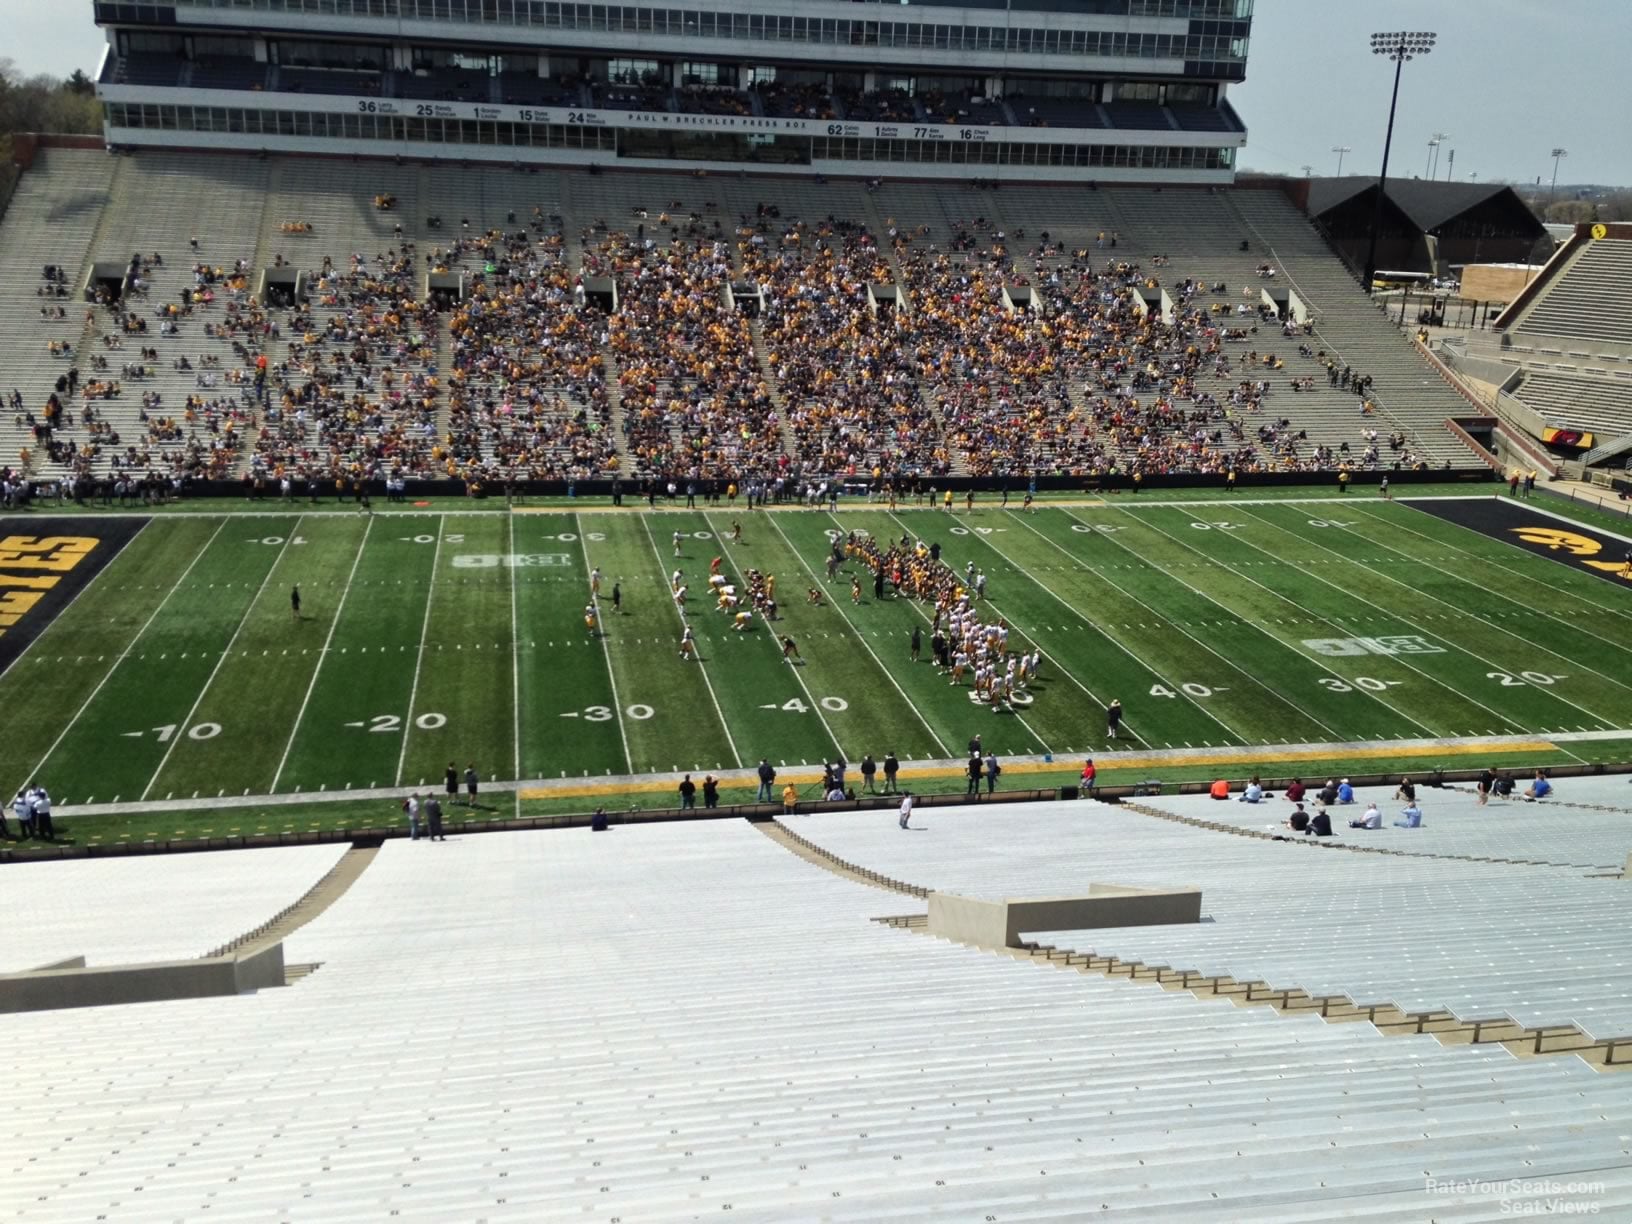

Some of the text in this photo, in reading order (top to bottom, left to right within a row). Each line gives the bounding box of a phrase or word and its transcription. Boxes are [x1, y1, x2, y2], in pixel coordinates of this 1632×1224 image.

[358, 100, 376, 113] 36
[416, 104, 433, 116] 25
[473, 107, 479, 118] 1
[519, 110, 532, 121] 15
[568, 112, 584, 123] 24
[628, 113, 657, 122] PAUL
[676, 116, 735, 125] BRECHLER
[742, 119, 777, 128] PRESS
[785, 121, 806, 129] BOX
[827, 124, 843, 135] 62
[874, 126, 880, 136] 1
[913, 127, 928, 138] 77
[959, 129, 972, 140] 16
[949, 526, 993, 536] 40
[1071, 524, 1118, 533] 30
[1190, 521, 1237, 531] 20
[262, 535, 309, 546] 10
[413, 534, 465, 545] 20
[558, 532, 607, 543] 30
[1486, 671, 1556, 688] 20
[1149, 682, 1213, 700] 40
[1318, 677, 1388, 694] 30
[782, 696, 850, 714] 40
[584, 704, 656, 722] 30
[368, 712, 448, 733] 20
[152, 722, 223, 742] 10
